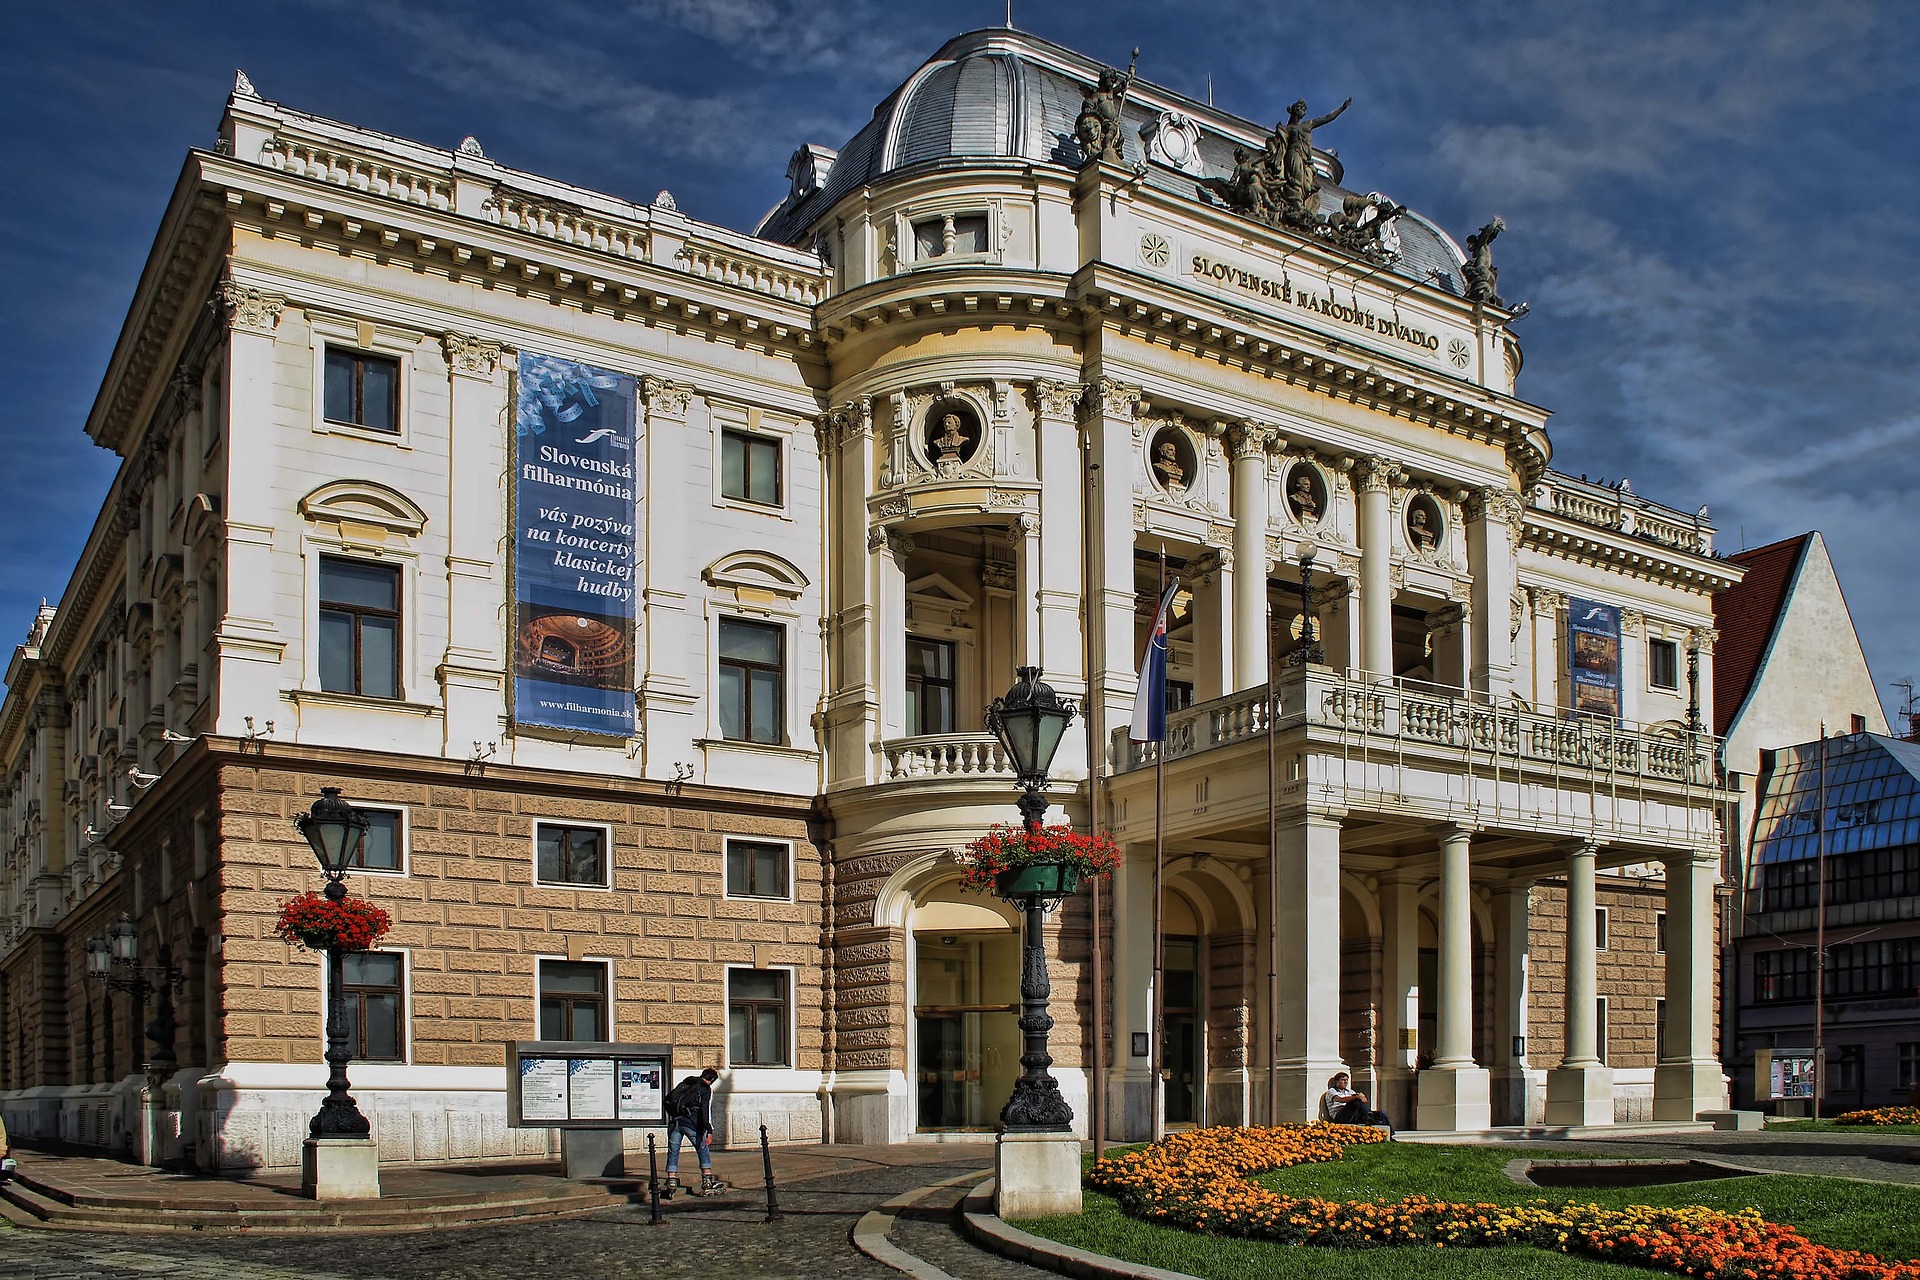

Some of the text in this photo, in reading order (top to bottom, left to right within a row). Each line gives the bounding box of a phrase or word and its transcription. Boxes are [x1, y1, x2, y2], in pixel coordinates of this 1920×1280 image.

[1192, 256, 1439, 351] SLOVENSKÉ NÁRODNÉ DIVADLO
[540, 445, 632, 479] Slovenská
[523, 464, 632, 500] filharmónia
[539, 507, 632, 536] vás pozýva
[527, 527, 632, 559] na koncerty
[554, 551, 632, 581] klasickej
[577, 577, 632, 602] hudby
[540, 700, 633, 719] www.filharmonia.sk
